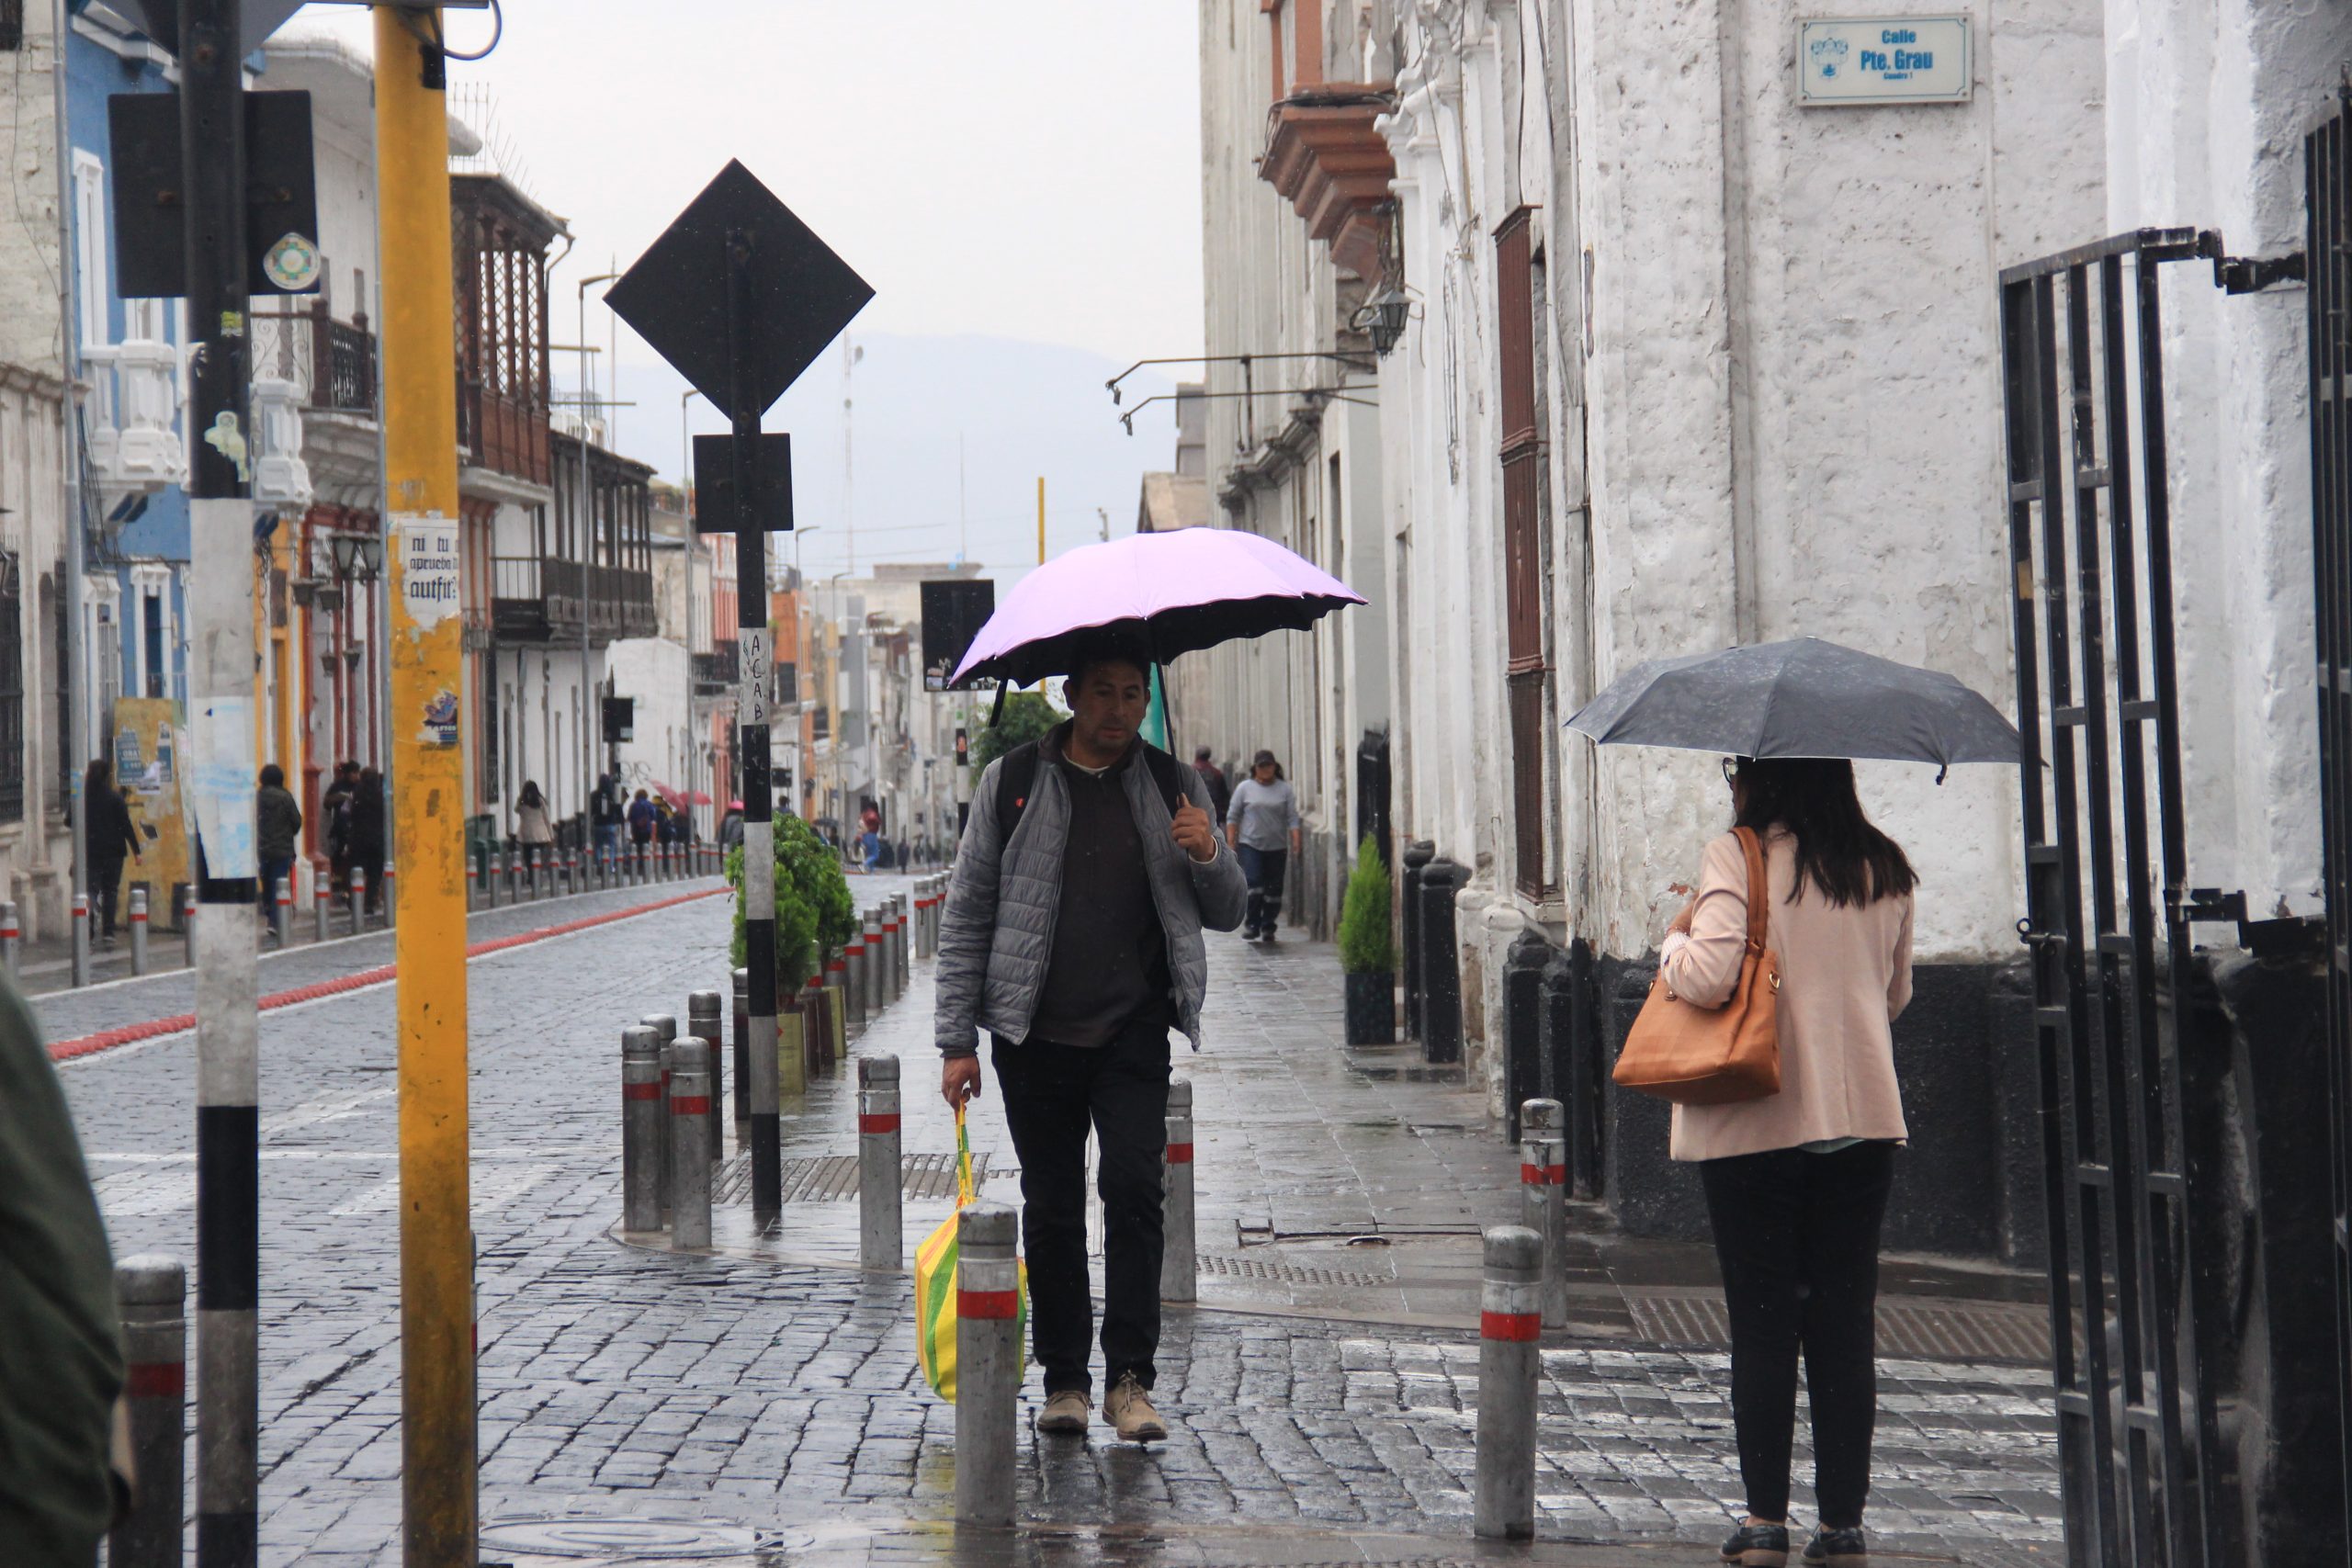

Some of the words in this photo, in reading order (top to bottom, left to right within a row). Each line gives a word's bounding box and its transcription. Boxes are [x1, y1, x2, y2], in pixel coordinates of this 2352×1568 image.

[1882, 29, 1917, 44] Calle
[1860, 50, 1891, 70] Pte.
[1894, 49, 1933, 69] Grau
[437, 536, 448, 552] tu
[411, 557, 451, 570] aprueba
